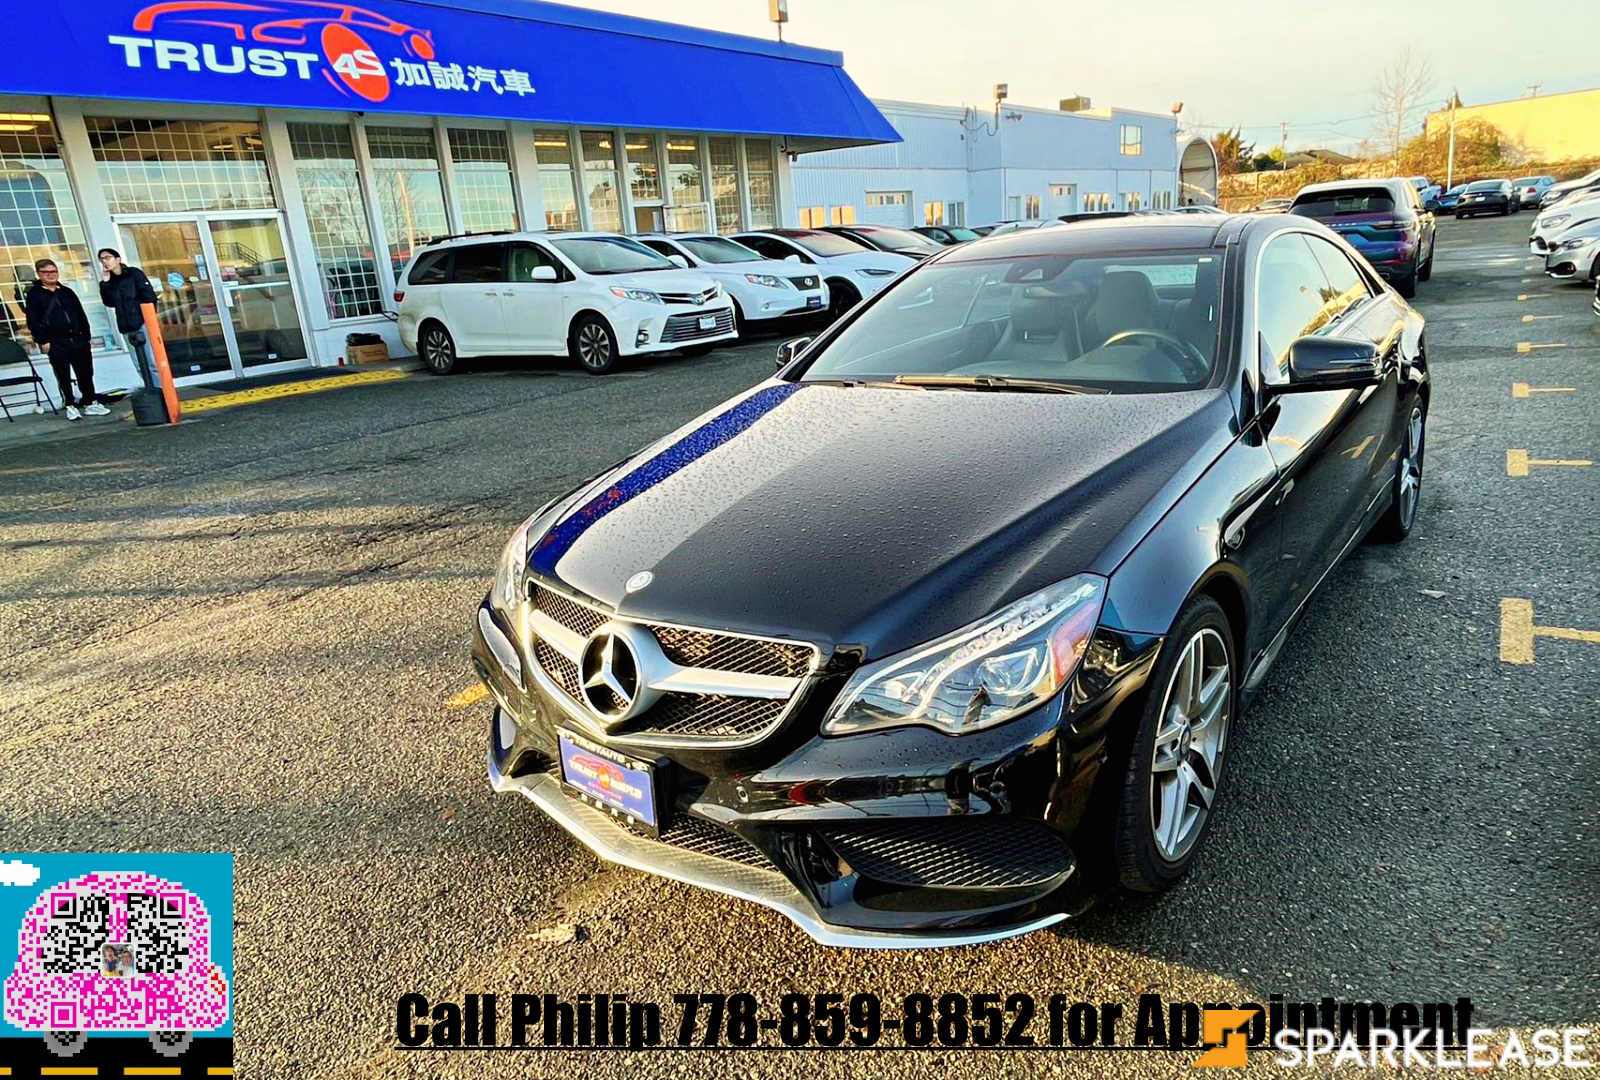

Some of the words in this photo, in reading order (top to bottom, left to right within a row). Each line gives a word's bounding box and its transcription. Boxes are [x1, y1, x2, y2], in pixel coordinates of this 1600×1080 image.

[108, 35, 319, 80] TRUST
[332, 49, 386, 80] 4S
[389, 57, 536, 97] 加誠汽車
